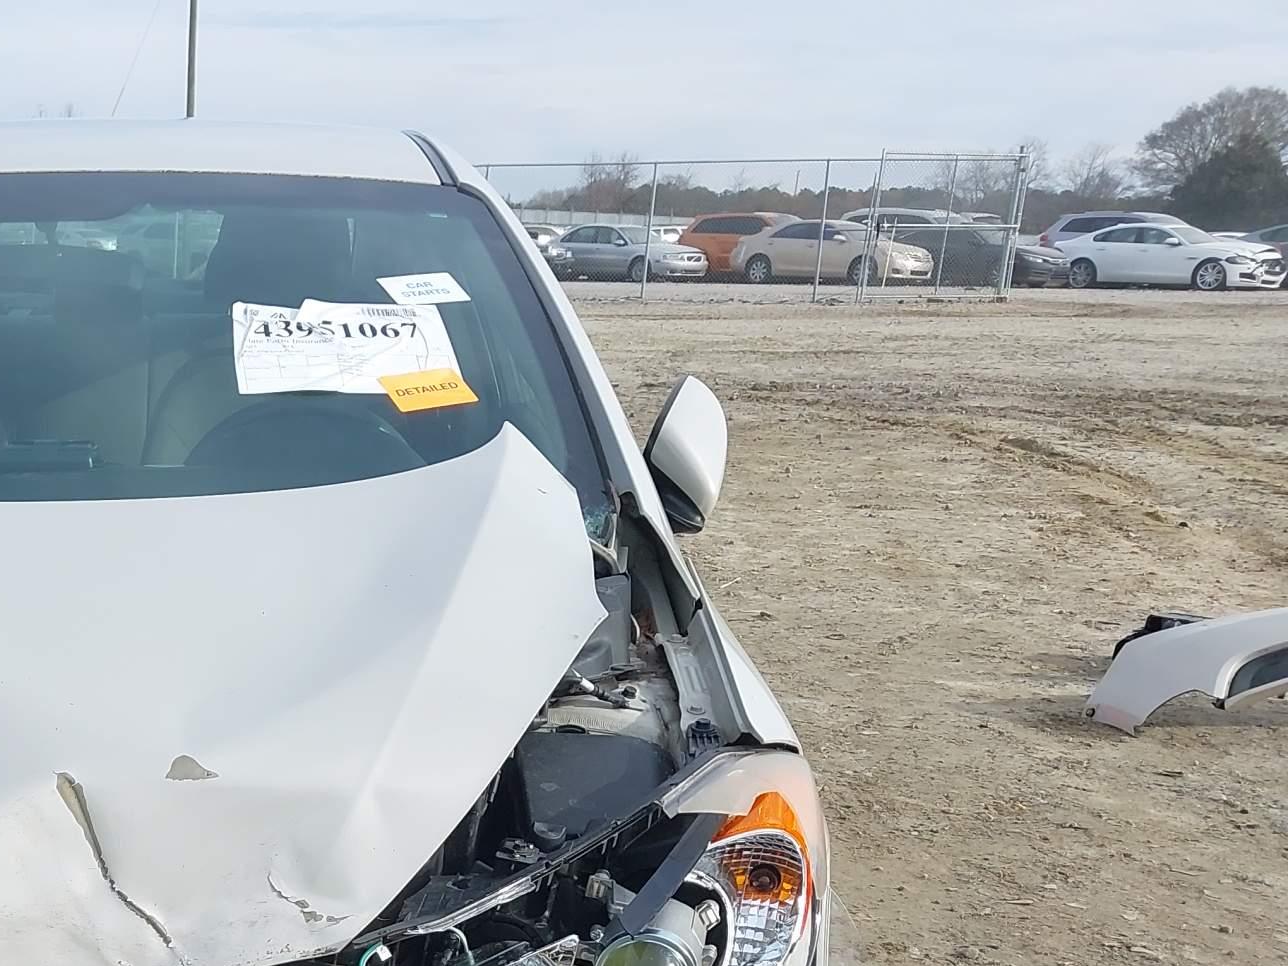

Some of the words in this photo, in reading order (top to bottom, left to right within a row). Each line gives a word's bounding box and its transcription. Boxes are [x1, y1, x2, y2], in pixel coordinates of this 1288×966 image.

[405, 281, 433, 289] CAR
[401, 288, 451, 297] STARTS
[253, 320, 417, 339] 43951067
[395, 381, 459, 397] DETAILED
